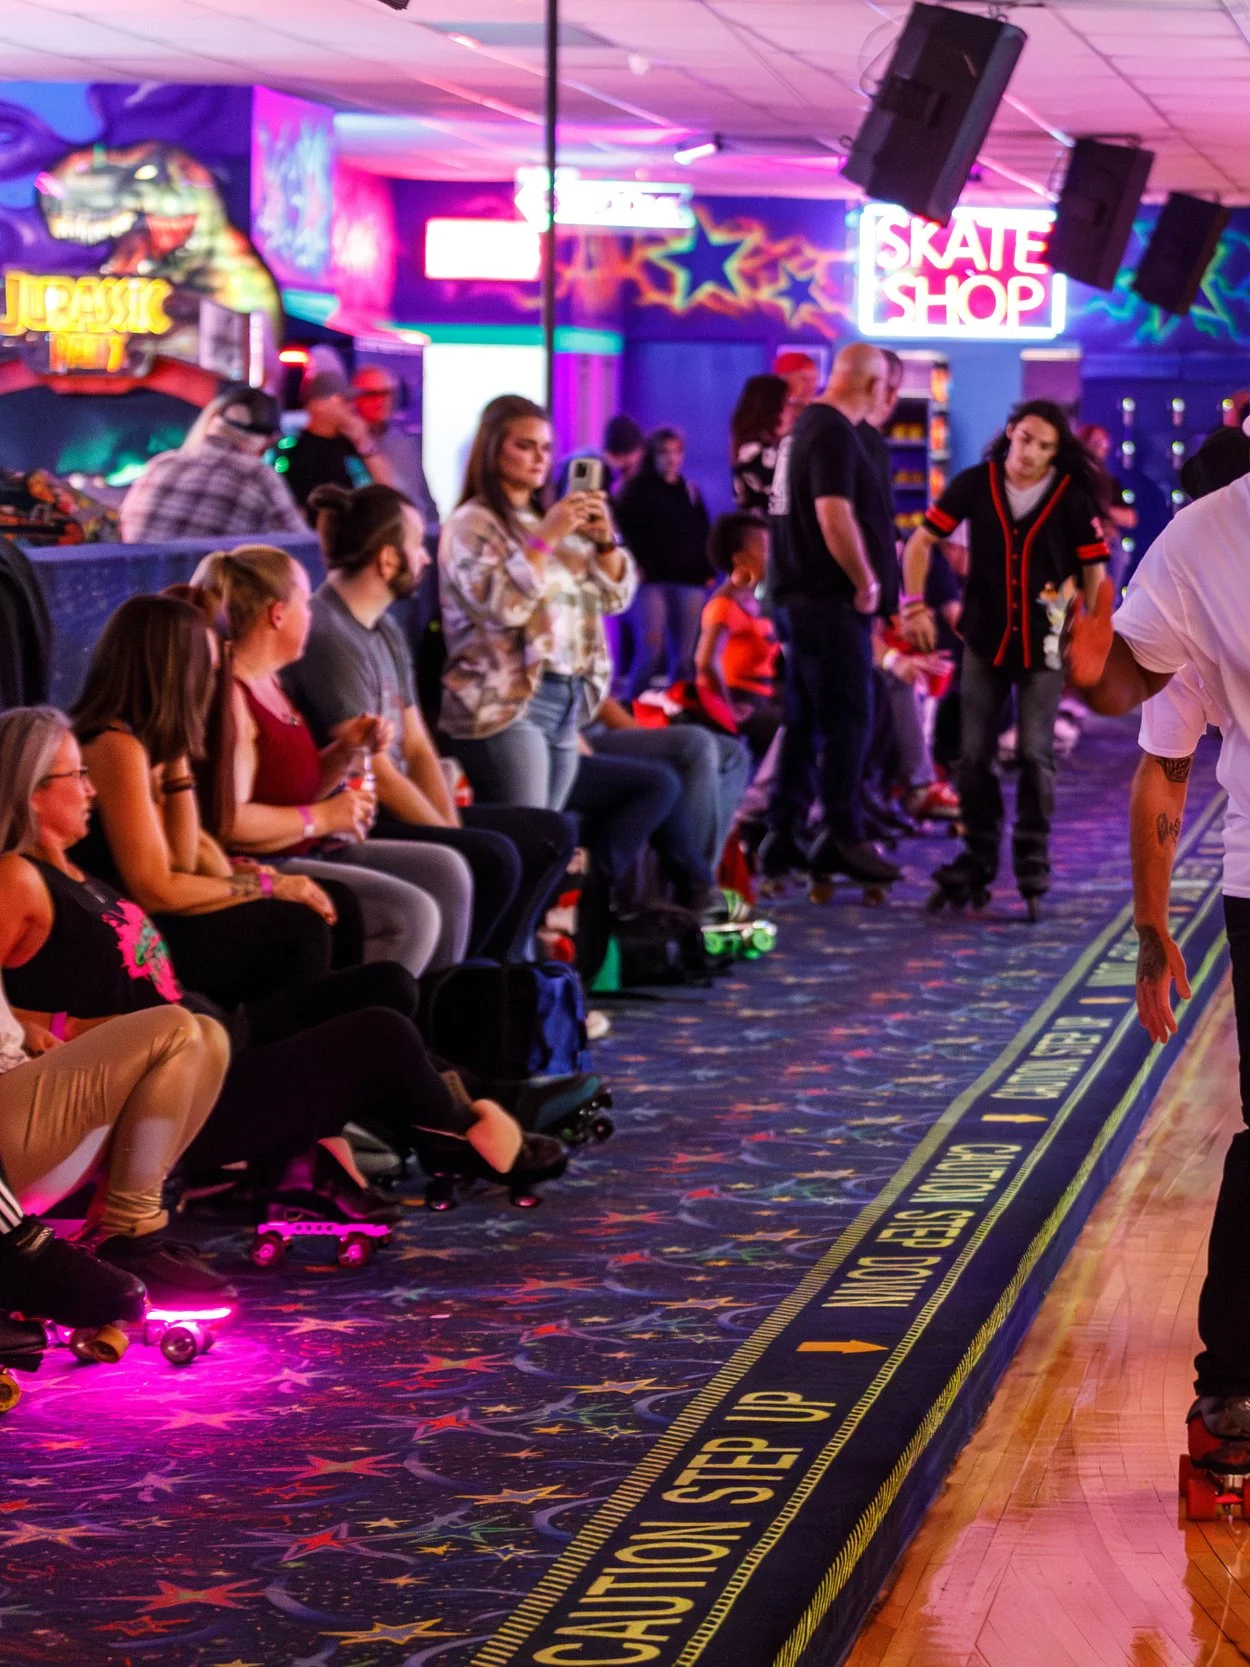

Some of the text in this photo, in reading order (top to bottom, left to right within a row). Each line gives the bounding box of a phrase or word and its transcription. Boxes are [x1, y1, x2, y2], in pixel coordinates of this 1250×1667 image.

[876, 214, 1051, 274] SKATE
[0, 270, 173, 336] JURASSIC
[884, 272, 1046, 328] SHOP
[821, 1143, 1023, 1308] CAUTION STEP DOWN
[531, 1391, 837, 1667] CAUTION STEP UP
